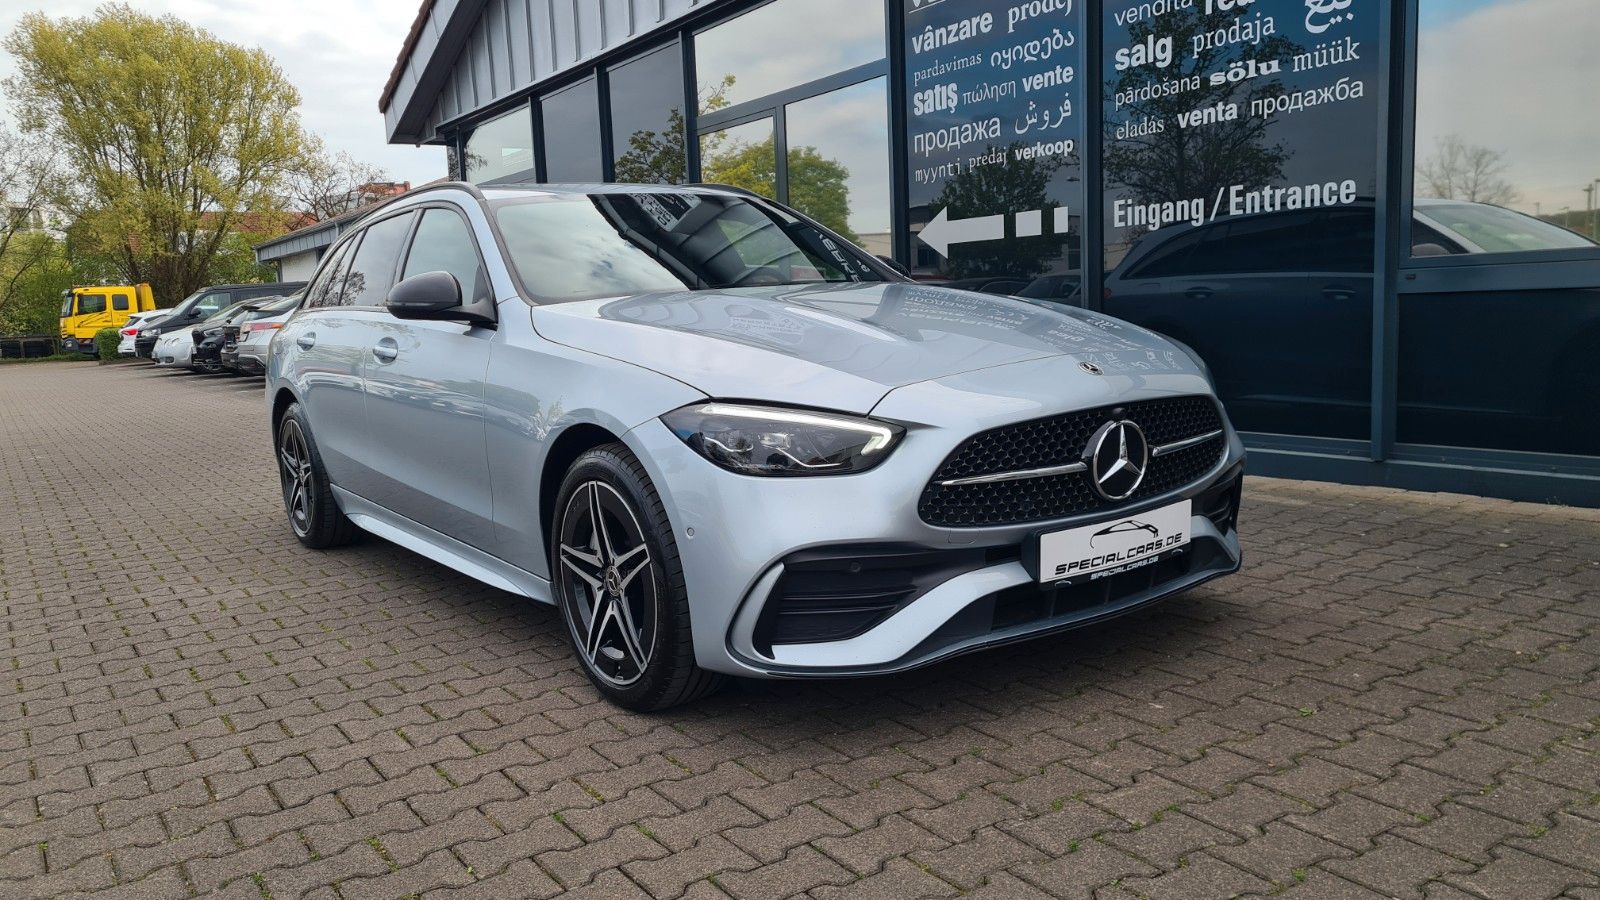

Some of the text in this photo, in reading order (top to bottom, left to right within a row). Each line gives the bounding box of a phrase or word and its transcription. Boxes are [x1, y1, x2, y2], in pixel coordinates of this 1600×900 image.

[912, 12, 993, 54] vânzare
[1114, 12, 1276, 71] salg prodaja
[914, 52, 982, 86] pardavimas
[1022, 65, 1074, 93] vente
[1115, 36, 1361, 111] pārdošana sölu müük
[962, 79, 1017, 106] πώληση
[1251, 77, 1364, 120] продажба
[914, 116, 1001, 157] продажа
[1115, 103, 1239, 140] eladás venta
[915, 139, 1074, 185] myynti predaj verkoop
[1113, 196, 1205, 232] Eingang
[1229, 178, 1357, 217] Entrance
[1055, 532, 1182, 576] SPECIALCARS.DE
